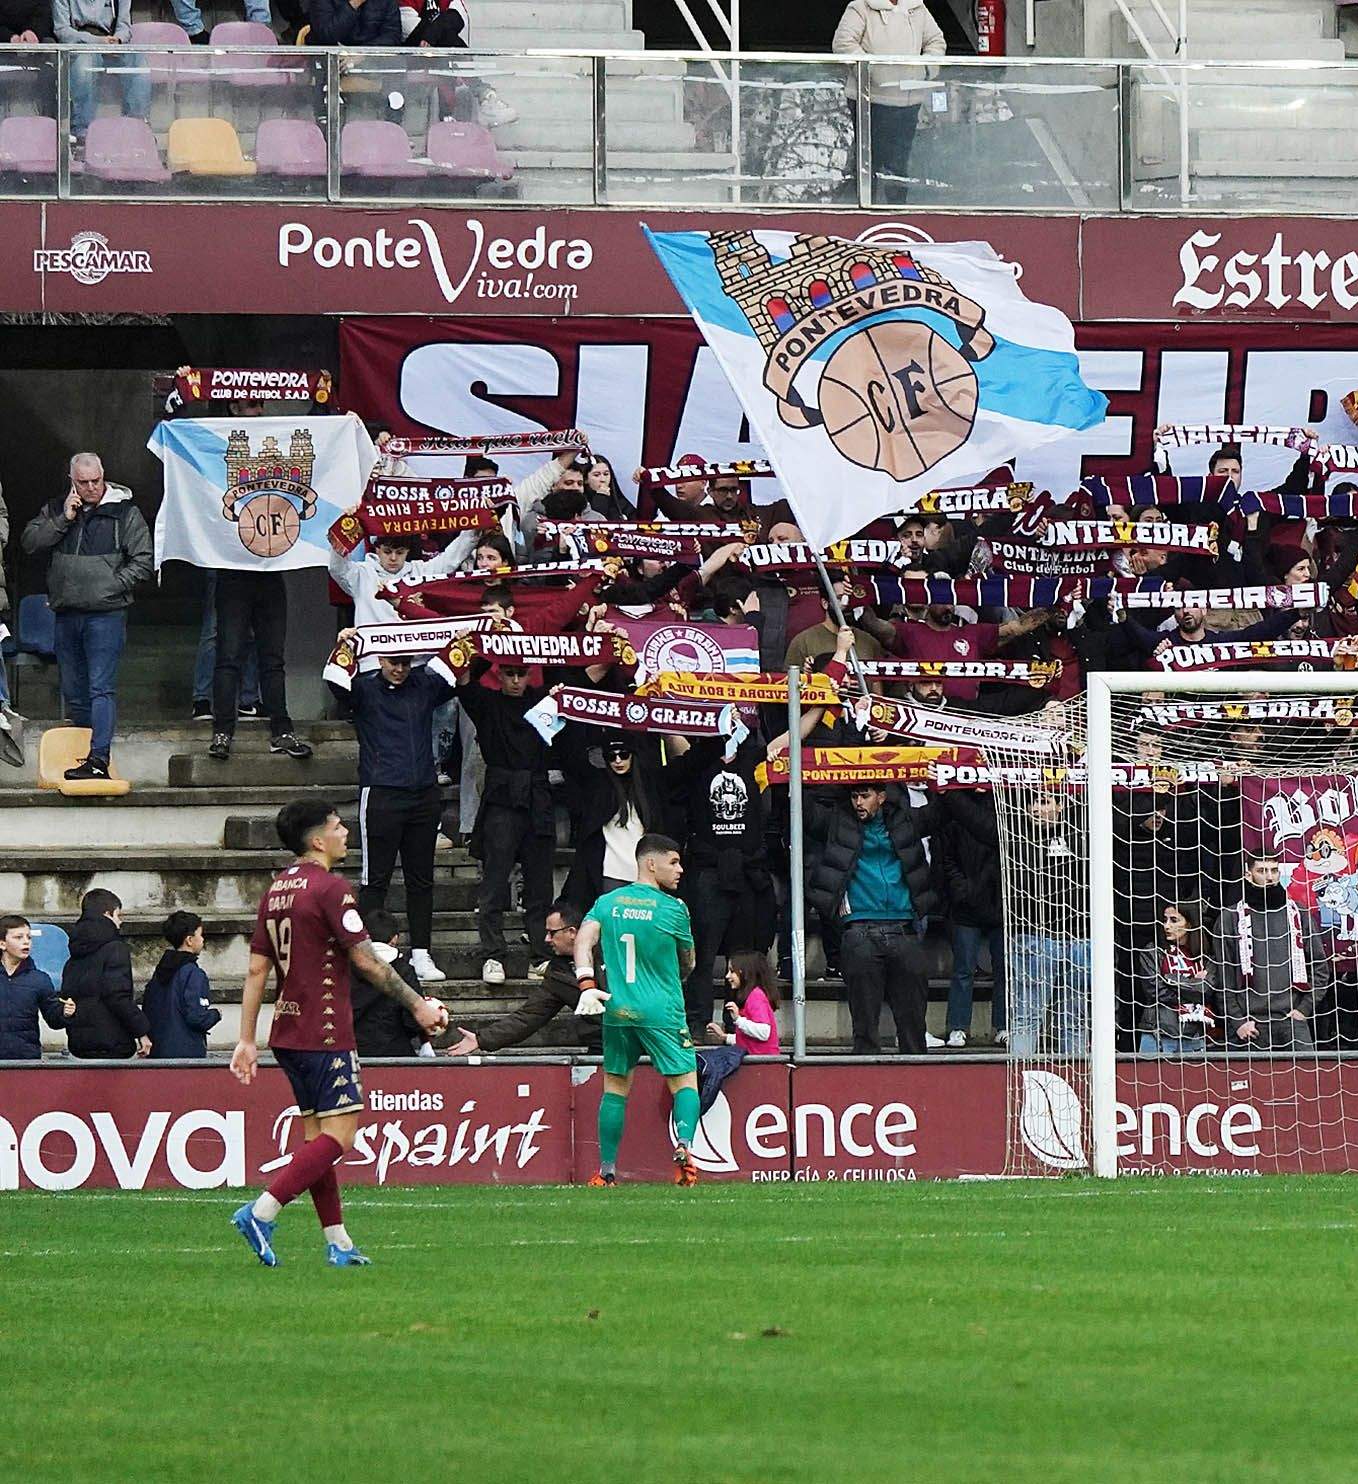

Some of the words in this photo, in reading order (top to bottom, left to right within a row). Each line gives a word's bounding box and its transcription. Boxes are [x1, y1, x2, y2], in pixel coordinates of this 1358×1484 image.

[34, 250, 153, 273] PESCAMAR
[776, 284, 961, 373] PONTEVEDRA
[210, 389, 232, 400] CLUB
[250, 390, 281, 400] FUTBOL
[867, 379, 896, 434] C
[892, 359, 928, 420] F
[232, 480, 309, 498] PONTEVEDRA
[376, 485, 430, 501] FOSSA
[367, 503, 411, 517] RINDE
[417, 502, 434, 514] SE
[256, 514, 266, 536] C
[269, 512, 284, 536] F
[383, 514, 479, 534] PONTEVEDRA
[739, 540, 901, 567] PONTVEDR
[991, 540, 1110, 562] PONTEVEDRA
[1003, 560, 1033, 574] Club
[1128, 583, 1315, 609] SIAREIRS
[370, 630, 452, 644] PONTEVEDRA
[481, 634, 580, 657] PONTEVEDRA
[581, 635, 603, 655] CF
[1156, 639, 1343, 672] PONTEVEDRA
[848, 661, 1030, 680] NTEVEDRA
[562, 694, 621, 717] FOSSA
[651, 707, 717, 727] GRANA
[802, 768, 897, 782] PONTEVEDRA
[909, 766, 928, 779] BO
[936, 764, 1153, 787] PONTEVERA
[269, 877, 308, 893] ABANCA
[612, 906, 620, 918] E.
[622, 908, 653, 920] SOUSA
[266, 917, 292, 979] 19
[619, 933, 636, 984] 1
[368, 1089, 444, 1111] tiendas
[745, 1102, 918, 1158] ence
[1115, 1102, 1262, 1158] ence
[0, 1109, 246, 1190] ova
